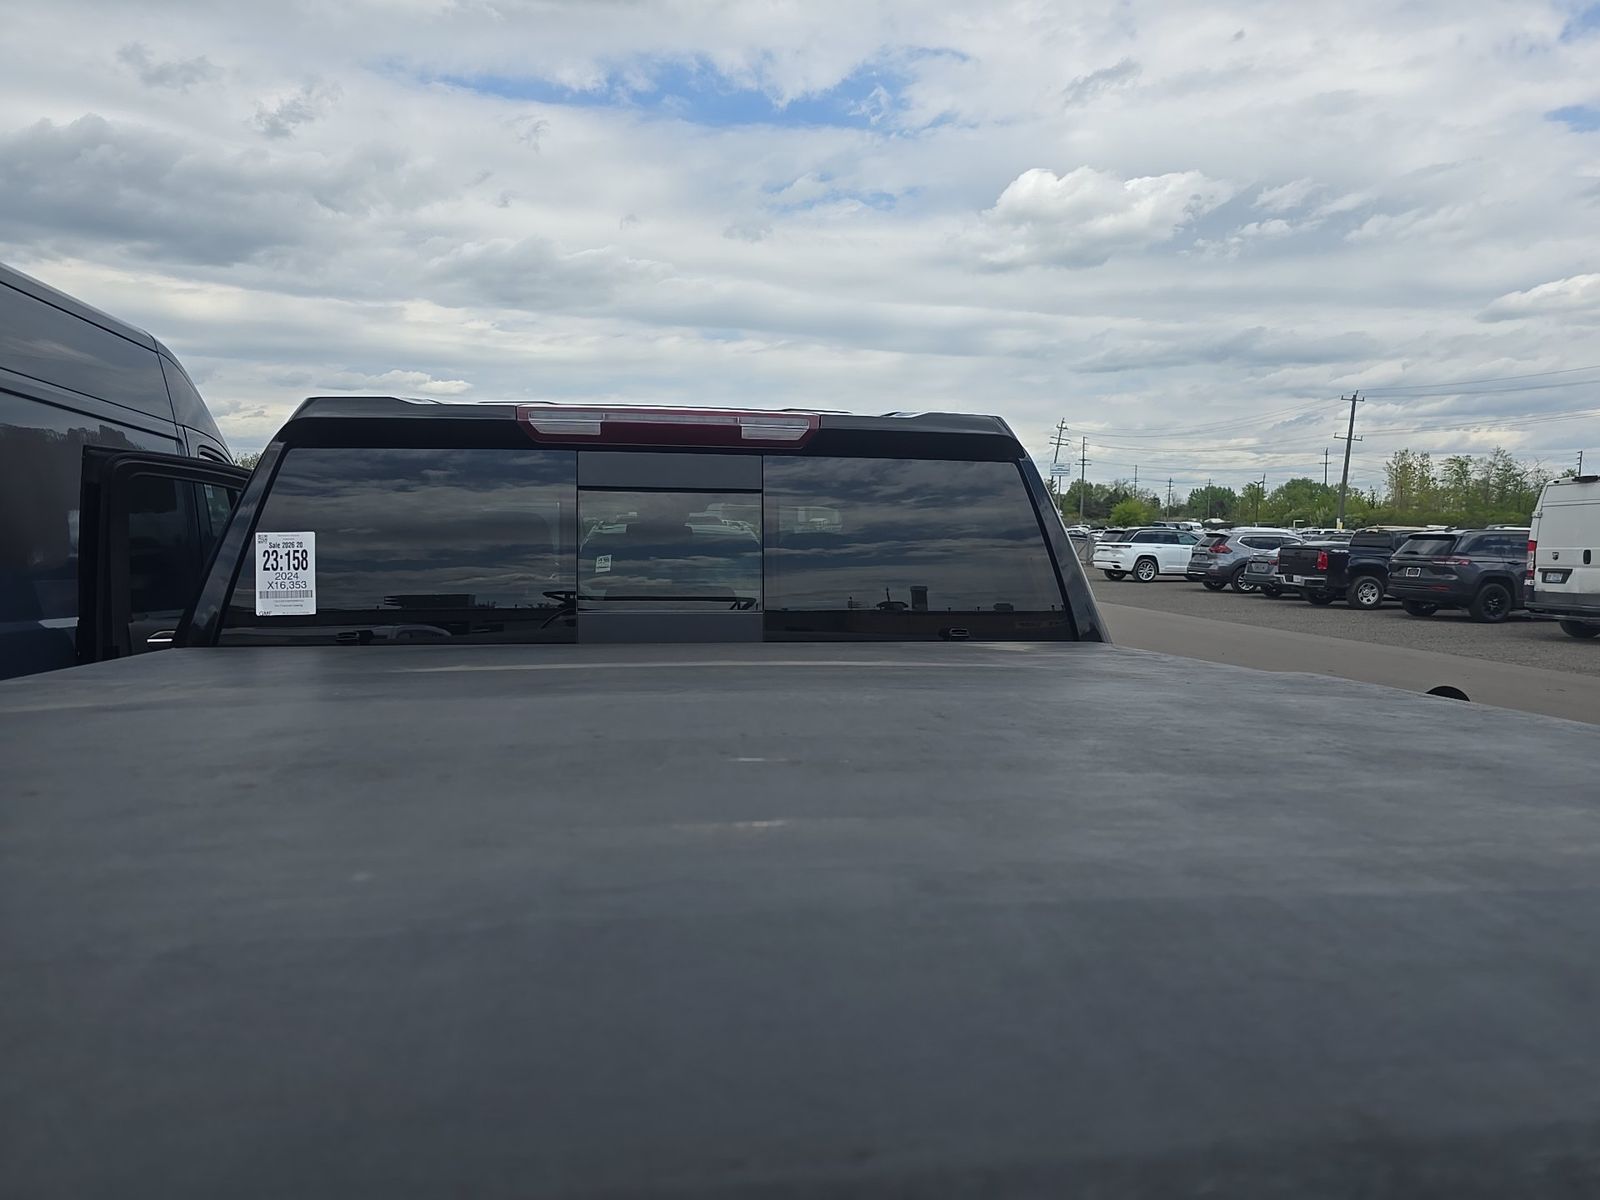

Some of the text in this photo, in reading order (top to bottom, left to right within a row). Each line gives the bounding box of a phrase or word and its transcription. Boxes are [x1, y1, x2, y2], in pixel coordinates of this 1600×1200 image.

[262, 549, 308, 571] 23:158
[275, 572, 299, 580] 2024
[267, 581, 307, 590] X16,353
